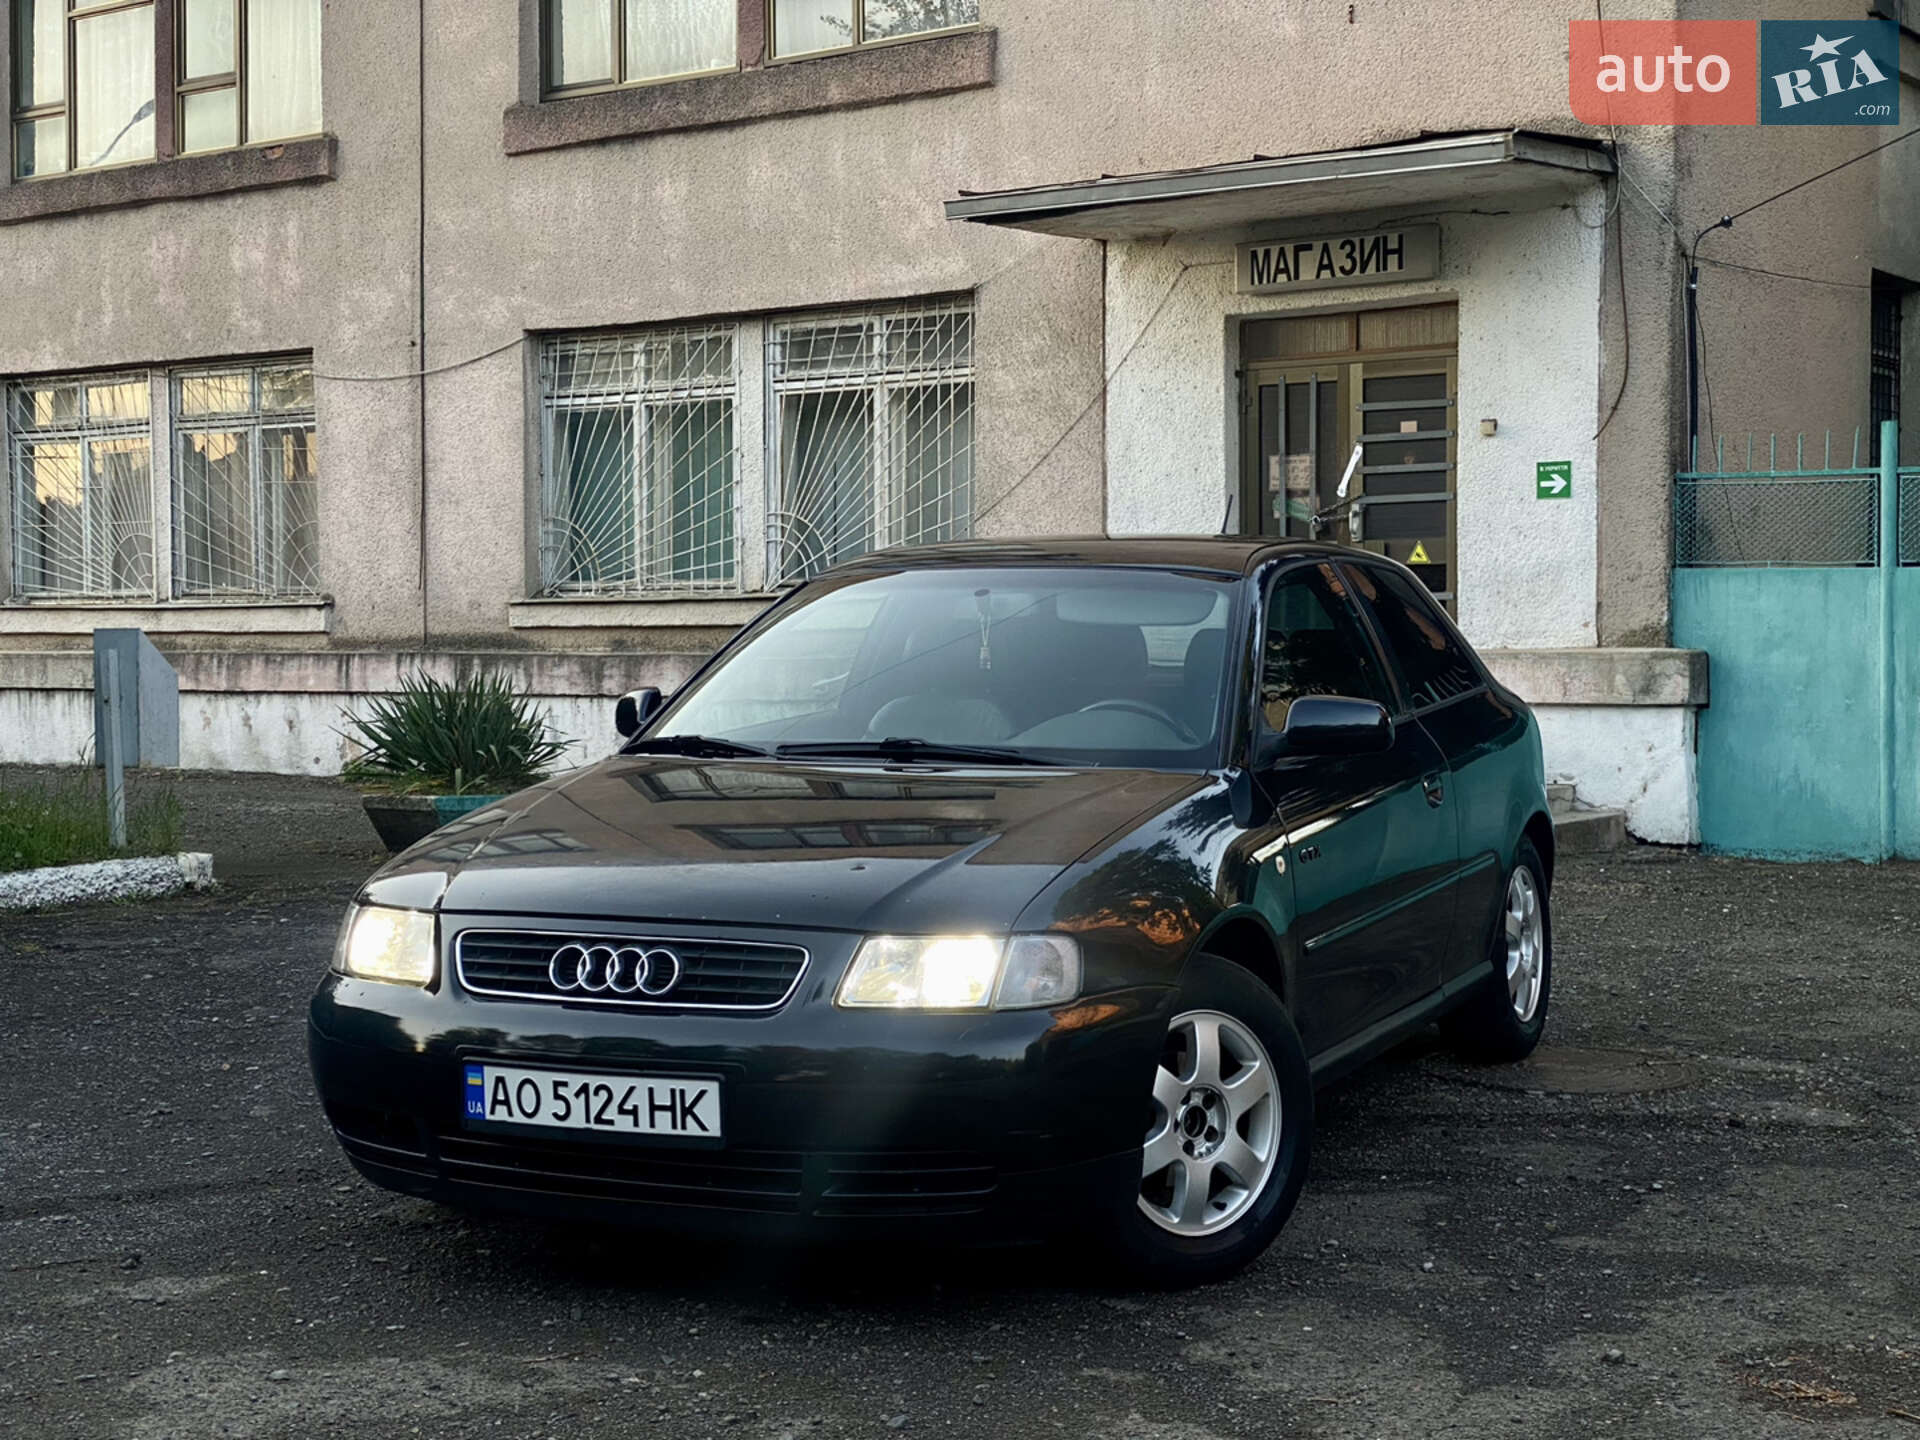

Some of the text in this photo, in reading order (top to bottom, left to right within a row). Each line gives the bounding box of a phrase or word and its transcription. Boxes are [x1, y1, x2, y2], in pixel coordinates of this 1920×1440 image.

[1250, 233, 1404, 286] МАГАЗИН
[467, 1101, 484, 1115] UA
[489, 1075, 710, 1132] AO 5124 HK
